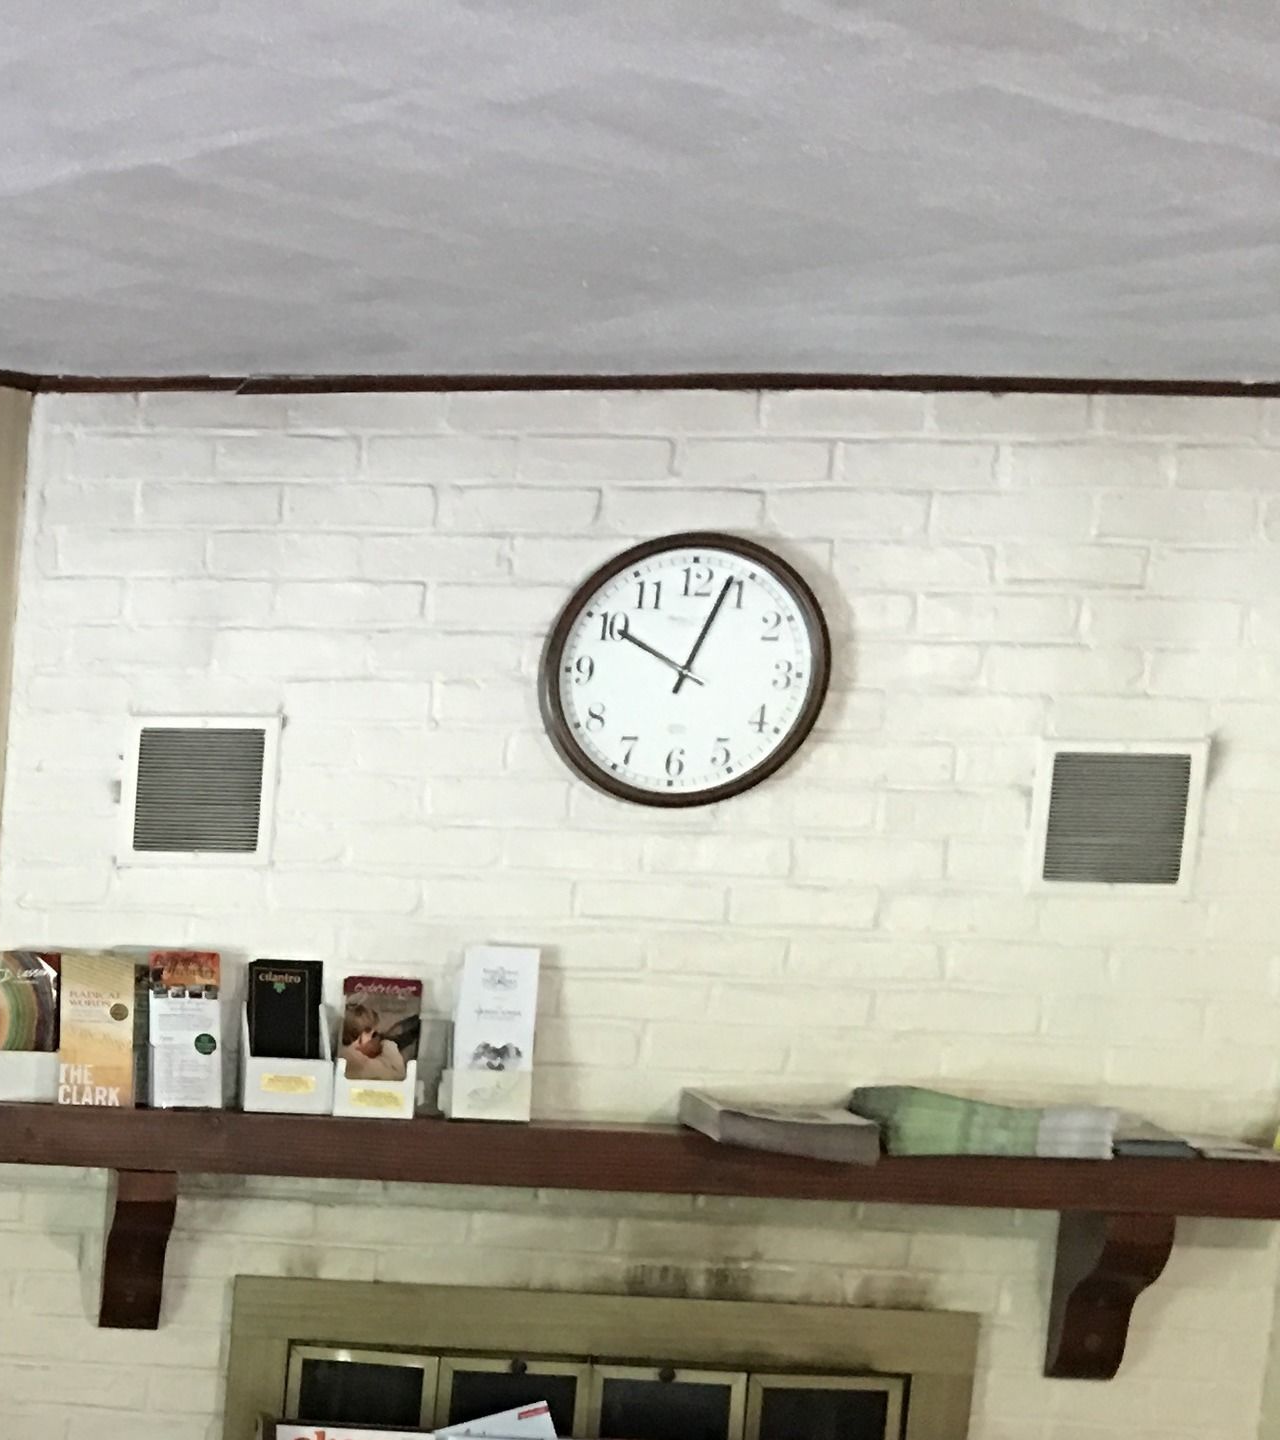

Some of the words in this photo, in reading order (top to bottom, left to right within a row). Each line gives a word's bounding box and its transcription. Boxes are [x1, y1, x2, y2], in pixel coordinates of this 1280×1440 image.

[636, 580, 662, 609] 11
[681, 567, 715, 597] 12
[733, 580, 745, 609] 1
[600, 612, 630, 641] 10
[760, 611, 782, 641] 2
[575, 656, 595, 685] 9
[772, 660, 792, 689] 3
[585, 702, 606, 731] 8
[748, 704, 769, 733] 4
[620, 736, 639, 765] 7
[665, 748, 685, 776] 6
[710, 737, 731, 766] 5
[259, 971, 302, 984] cilantro
[59, 1063, 95, 1085] THE
[58, 1084, 121, 1107] CLARK
